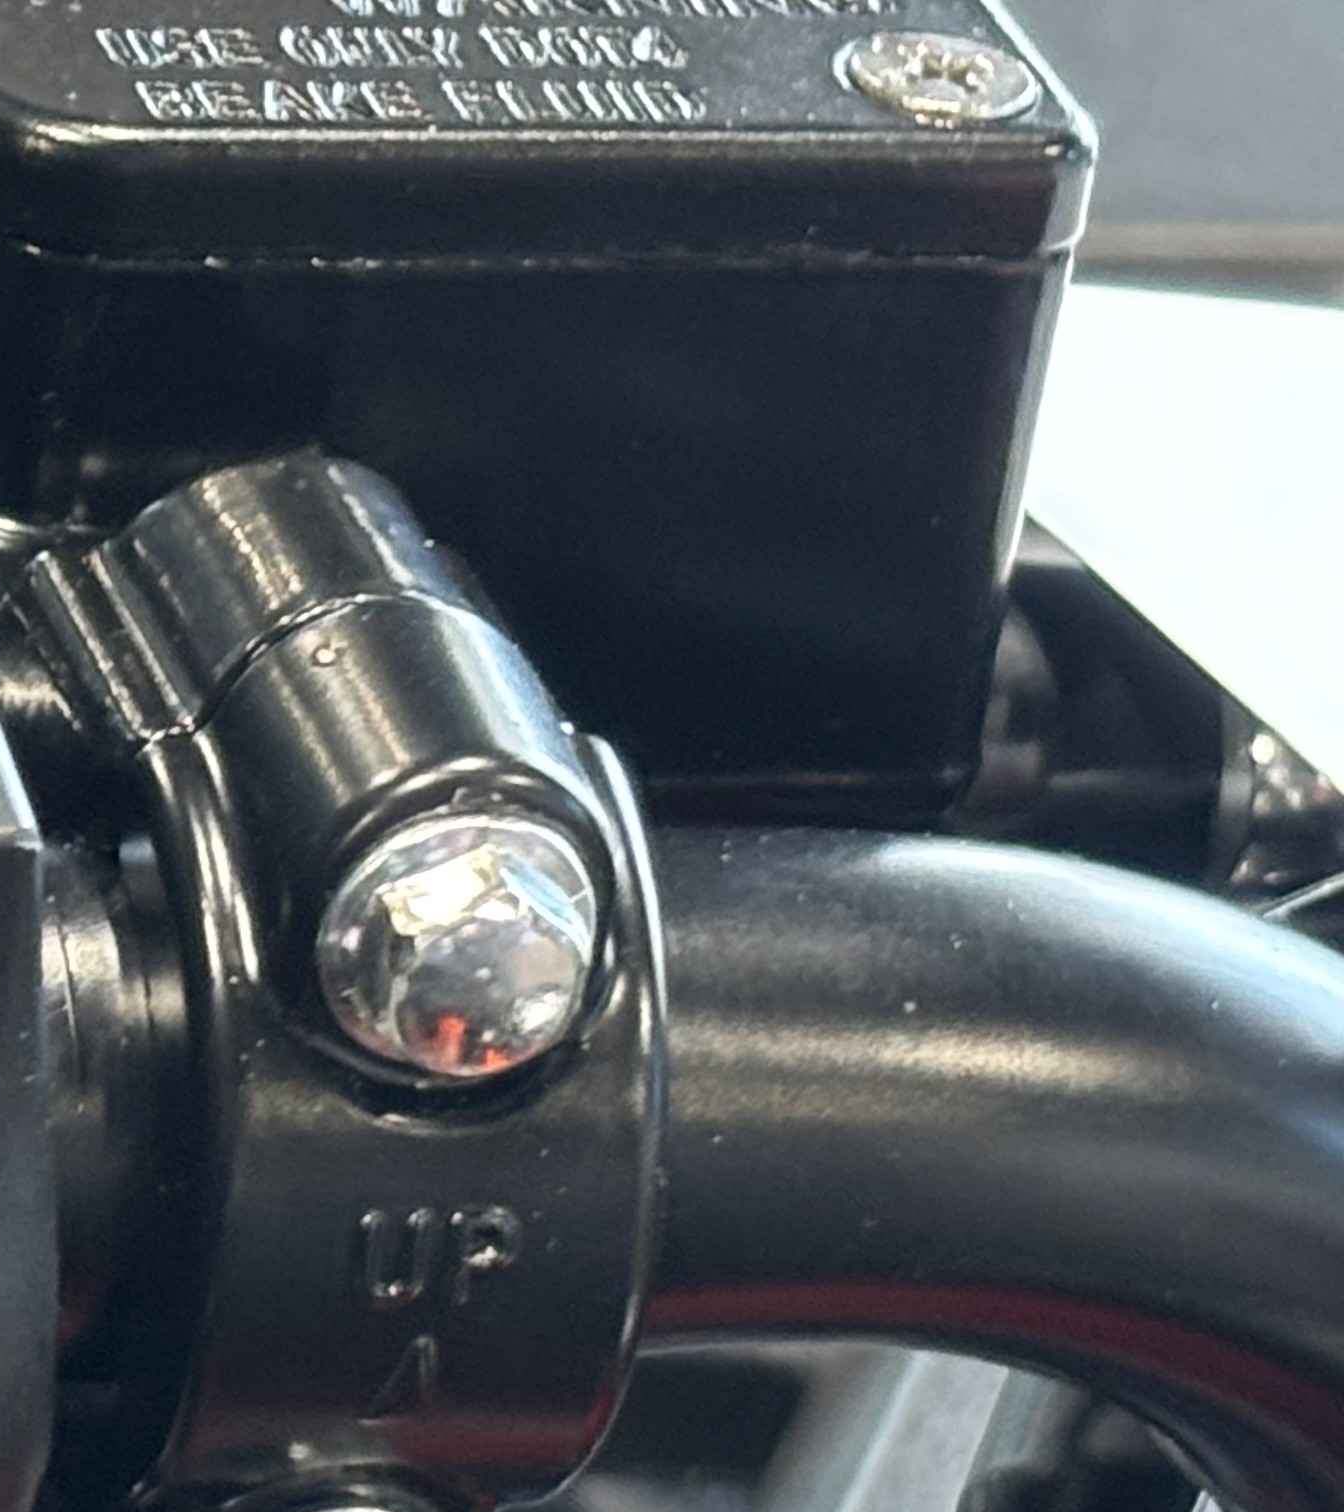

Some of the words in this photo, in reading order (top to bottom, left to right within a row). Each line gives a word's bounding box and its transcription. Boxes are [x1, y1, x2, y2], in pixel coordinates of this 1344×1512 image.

[96, 27, 264, 68] USE
[278, 25, 463, 68] ONLY
[135, 81, 433, 121] BRAKE
[360, 1206, 522, 1306] UP
